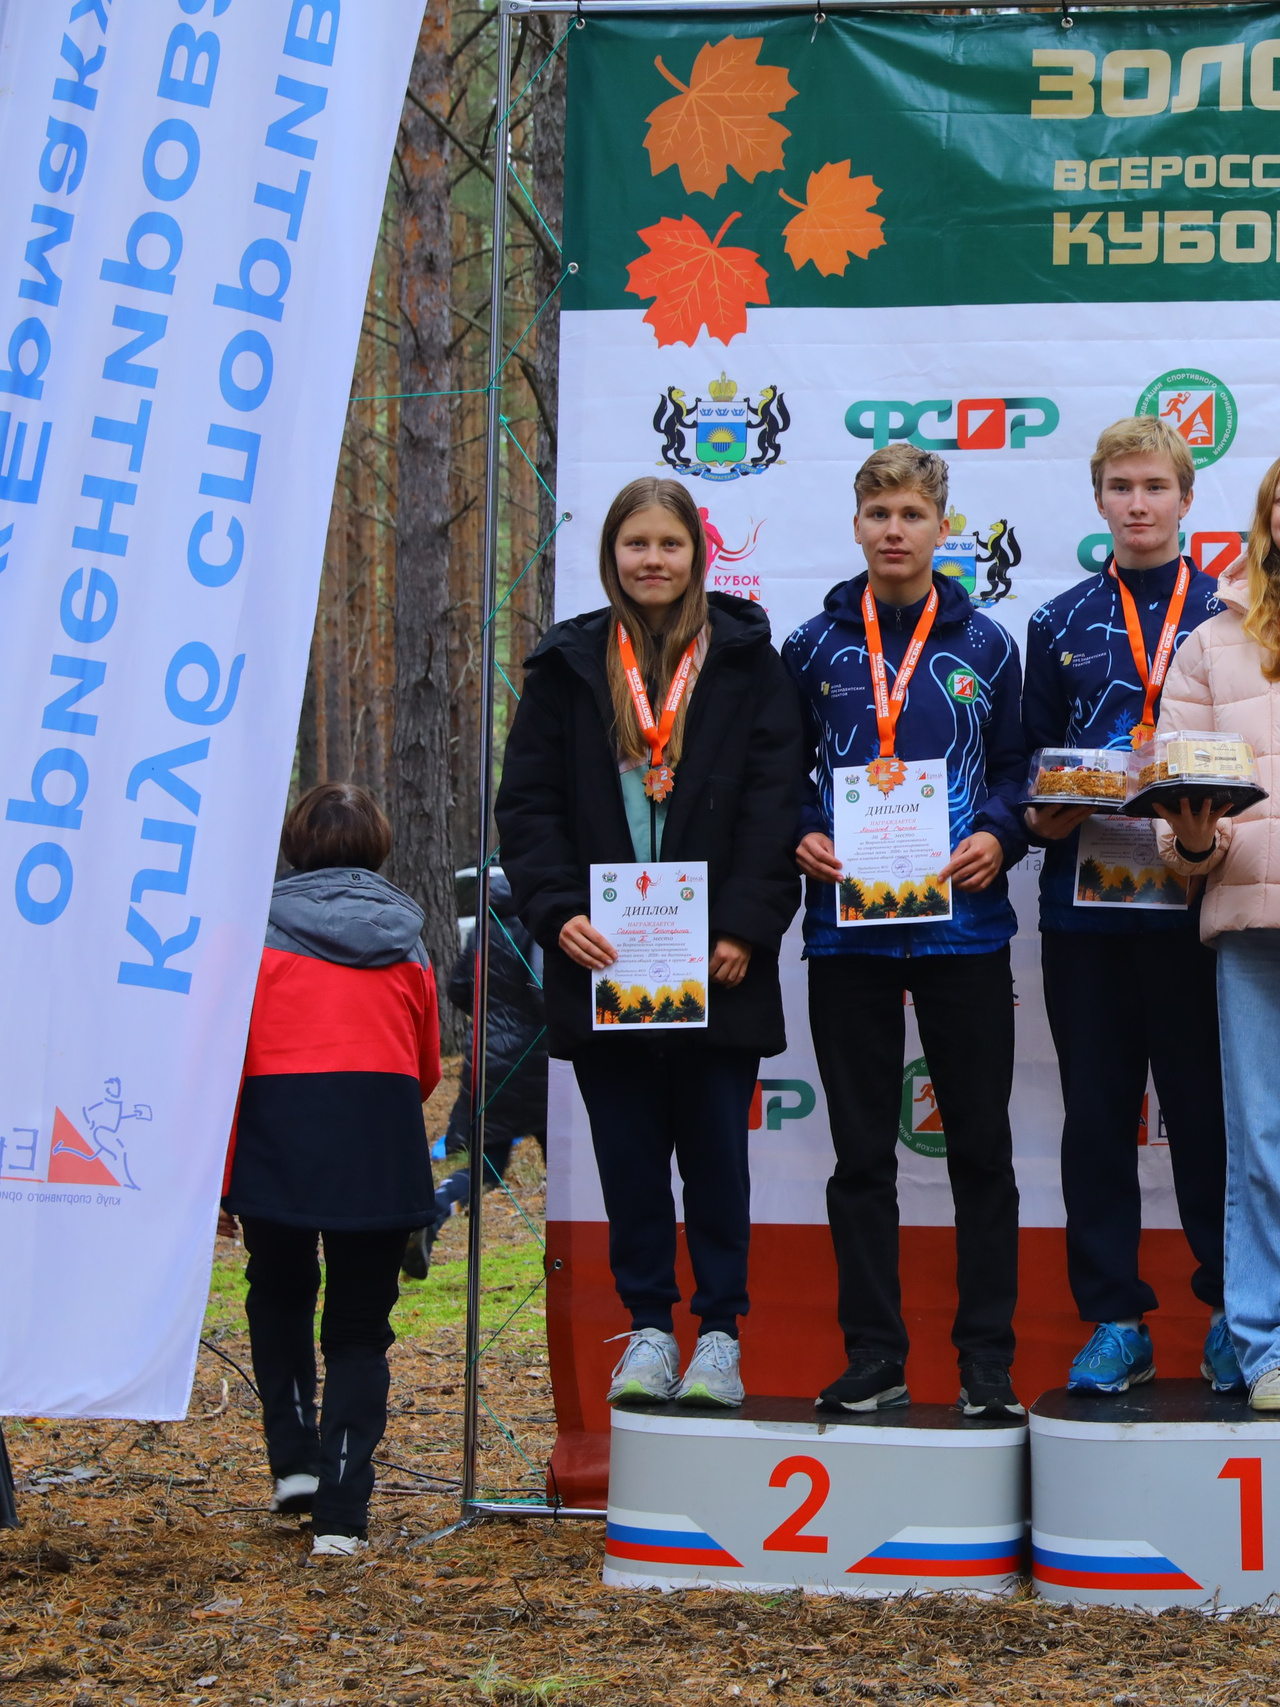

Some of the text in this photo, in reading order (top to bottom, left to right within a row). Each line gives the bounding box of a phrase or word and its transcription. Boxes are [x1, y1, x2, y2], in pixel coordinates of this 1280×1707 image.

[1166, 373, 1218, 389] СПОРТИВНОГО
[1139, 382, 1163, 418] ЕДЕРАЦИЯ
[714, 575, 760, 586] КУБОК
[889, 762, 899, 772] 2
[865, 803, 919, 817] ДИПЛОМ
[622, 905, 679, 918] ДИПЛОМ
[762, 1457, 831, 1553] 2
[1217, 1458, 1264, 1572] 1
